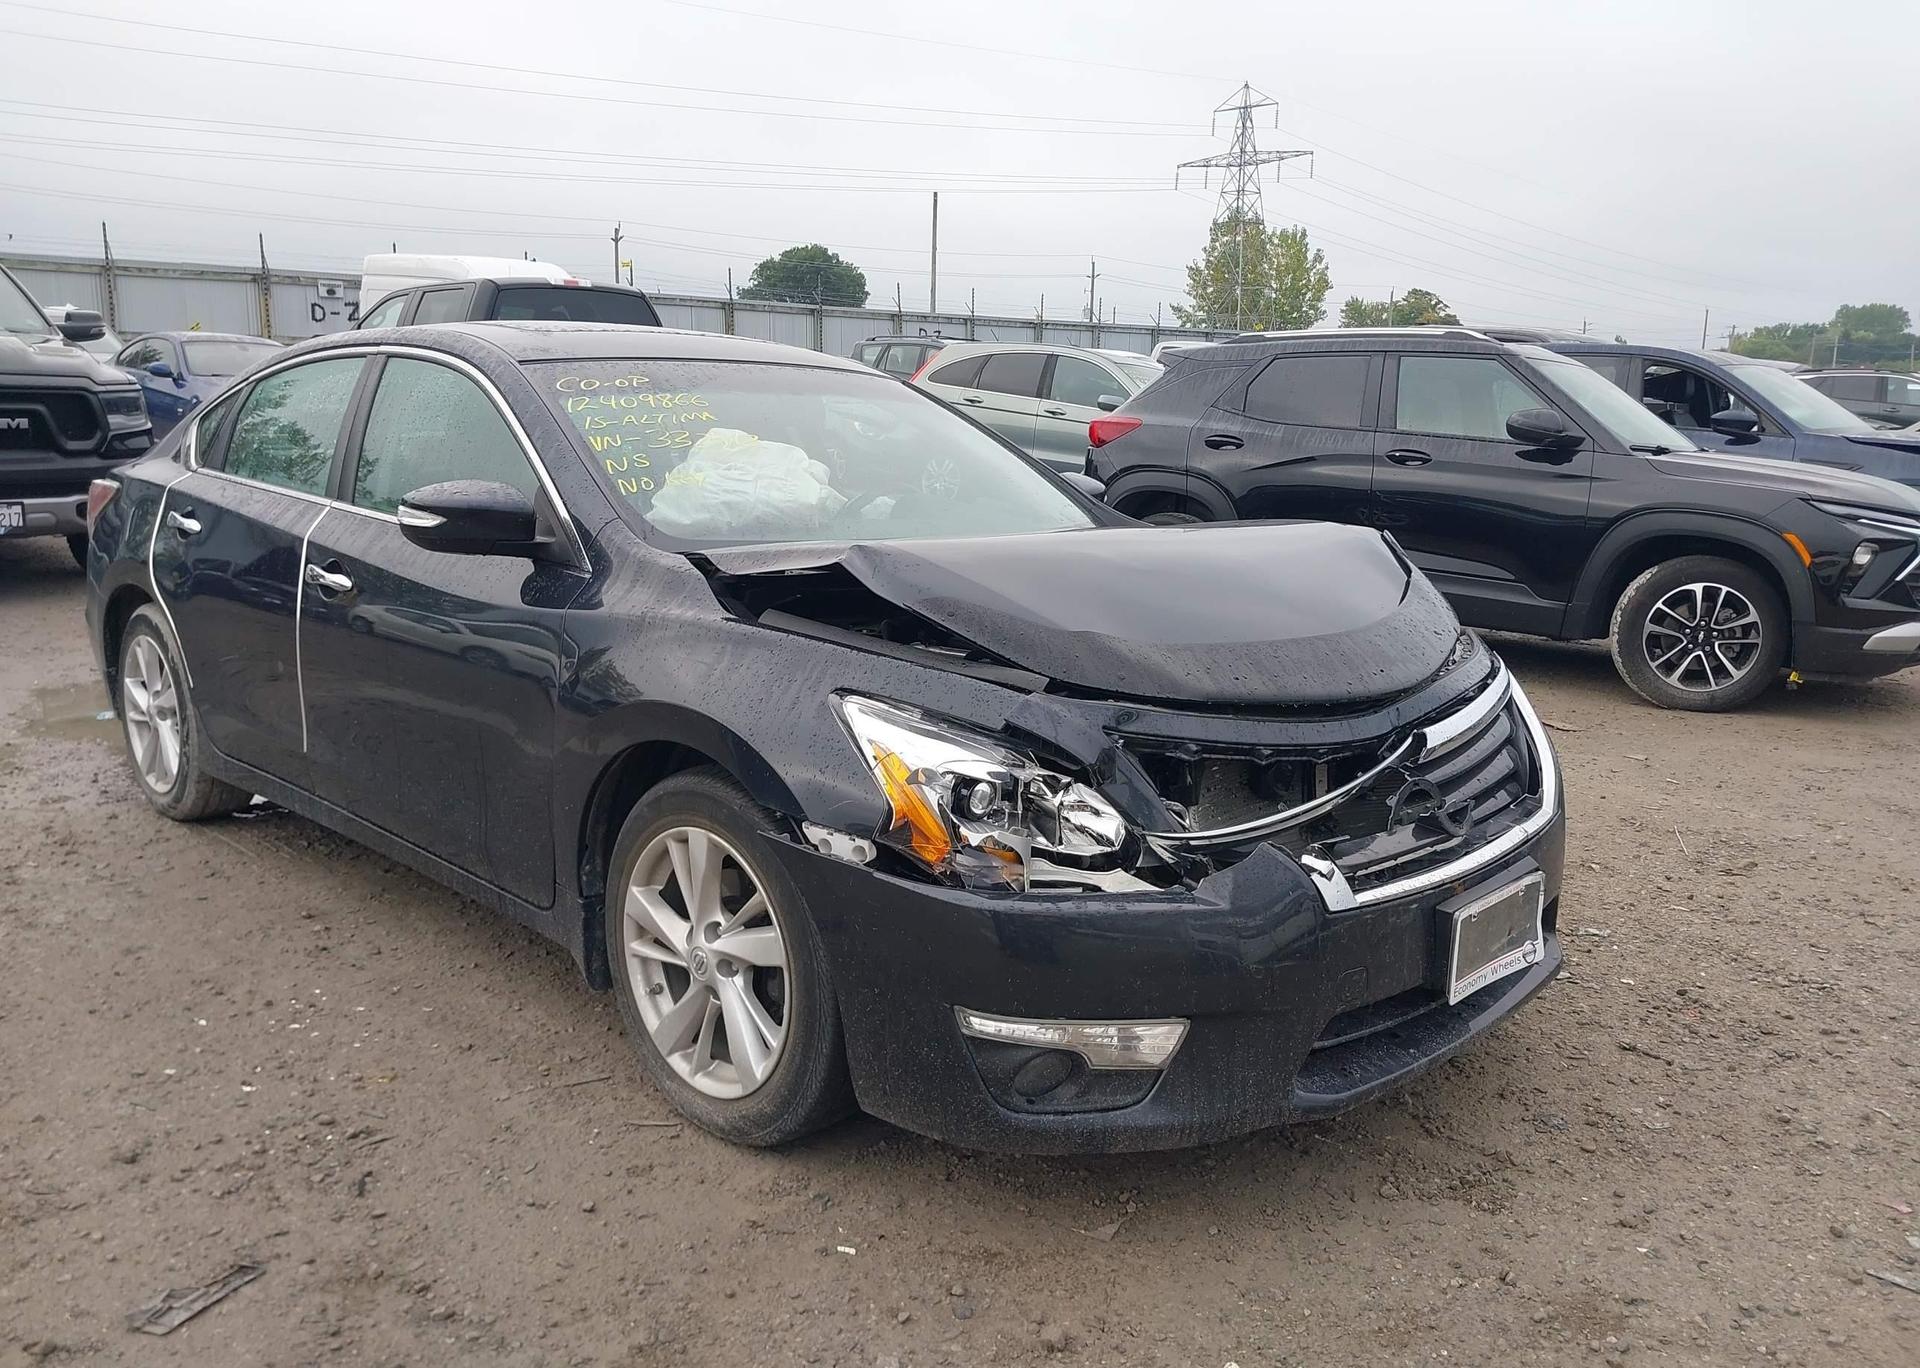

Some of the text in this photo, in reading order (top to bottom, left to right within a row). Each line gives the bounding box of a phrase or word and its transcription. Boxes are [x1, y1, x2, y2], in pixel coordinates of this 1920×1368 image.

[556, 375, 650, 392] CO-OP
[618, 477, 655, 496] NO
[1453, 955, 1522, 998] Economy Wheels
